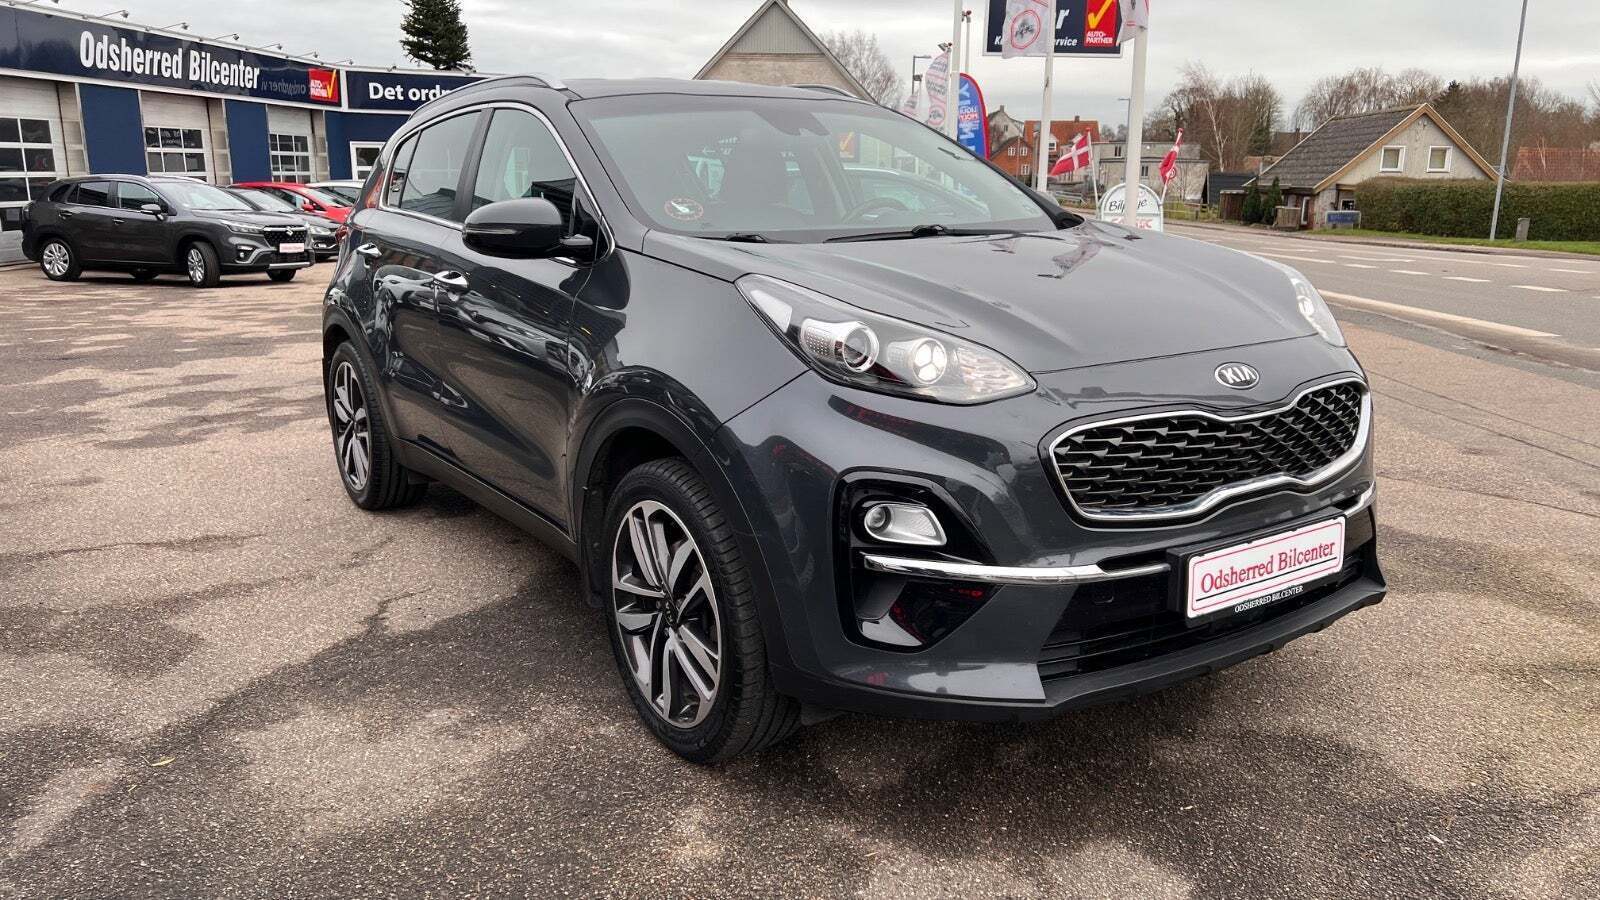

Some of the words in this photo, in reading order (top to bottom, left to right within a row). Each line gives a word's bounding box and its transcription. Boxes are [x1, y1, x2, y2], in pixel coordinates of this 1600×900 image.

[1054, 37, 1077, 47] rvice
[80, 31, 183, 79] Odsherred
[189, 50, 260, 89] Bilcenter
[368, 82, 404, 100] Det
[1220, 366, 1256, 384] KIA
[1201, 555, 1274, 593] Odsherred
[1278, 542, 1336, 571] Bilcenter
[1234, 595, 1272, 613] ODSHERRED
[1272, 585, 1304, 603] BILCENTER
